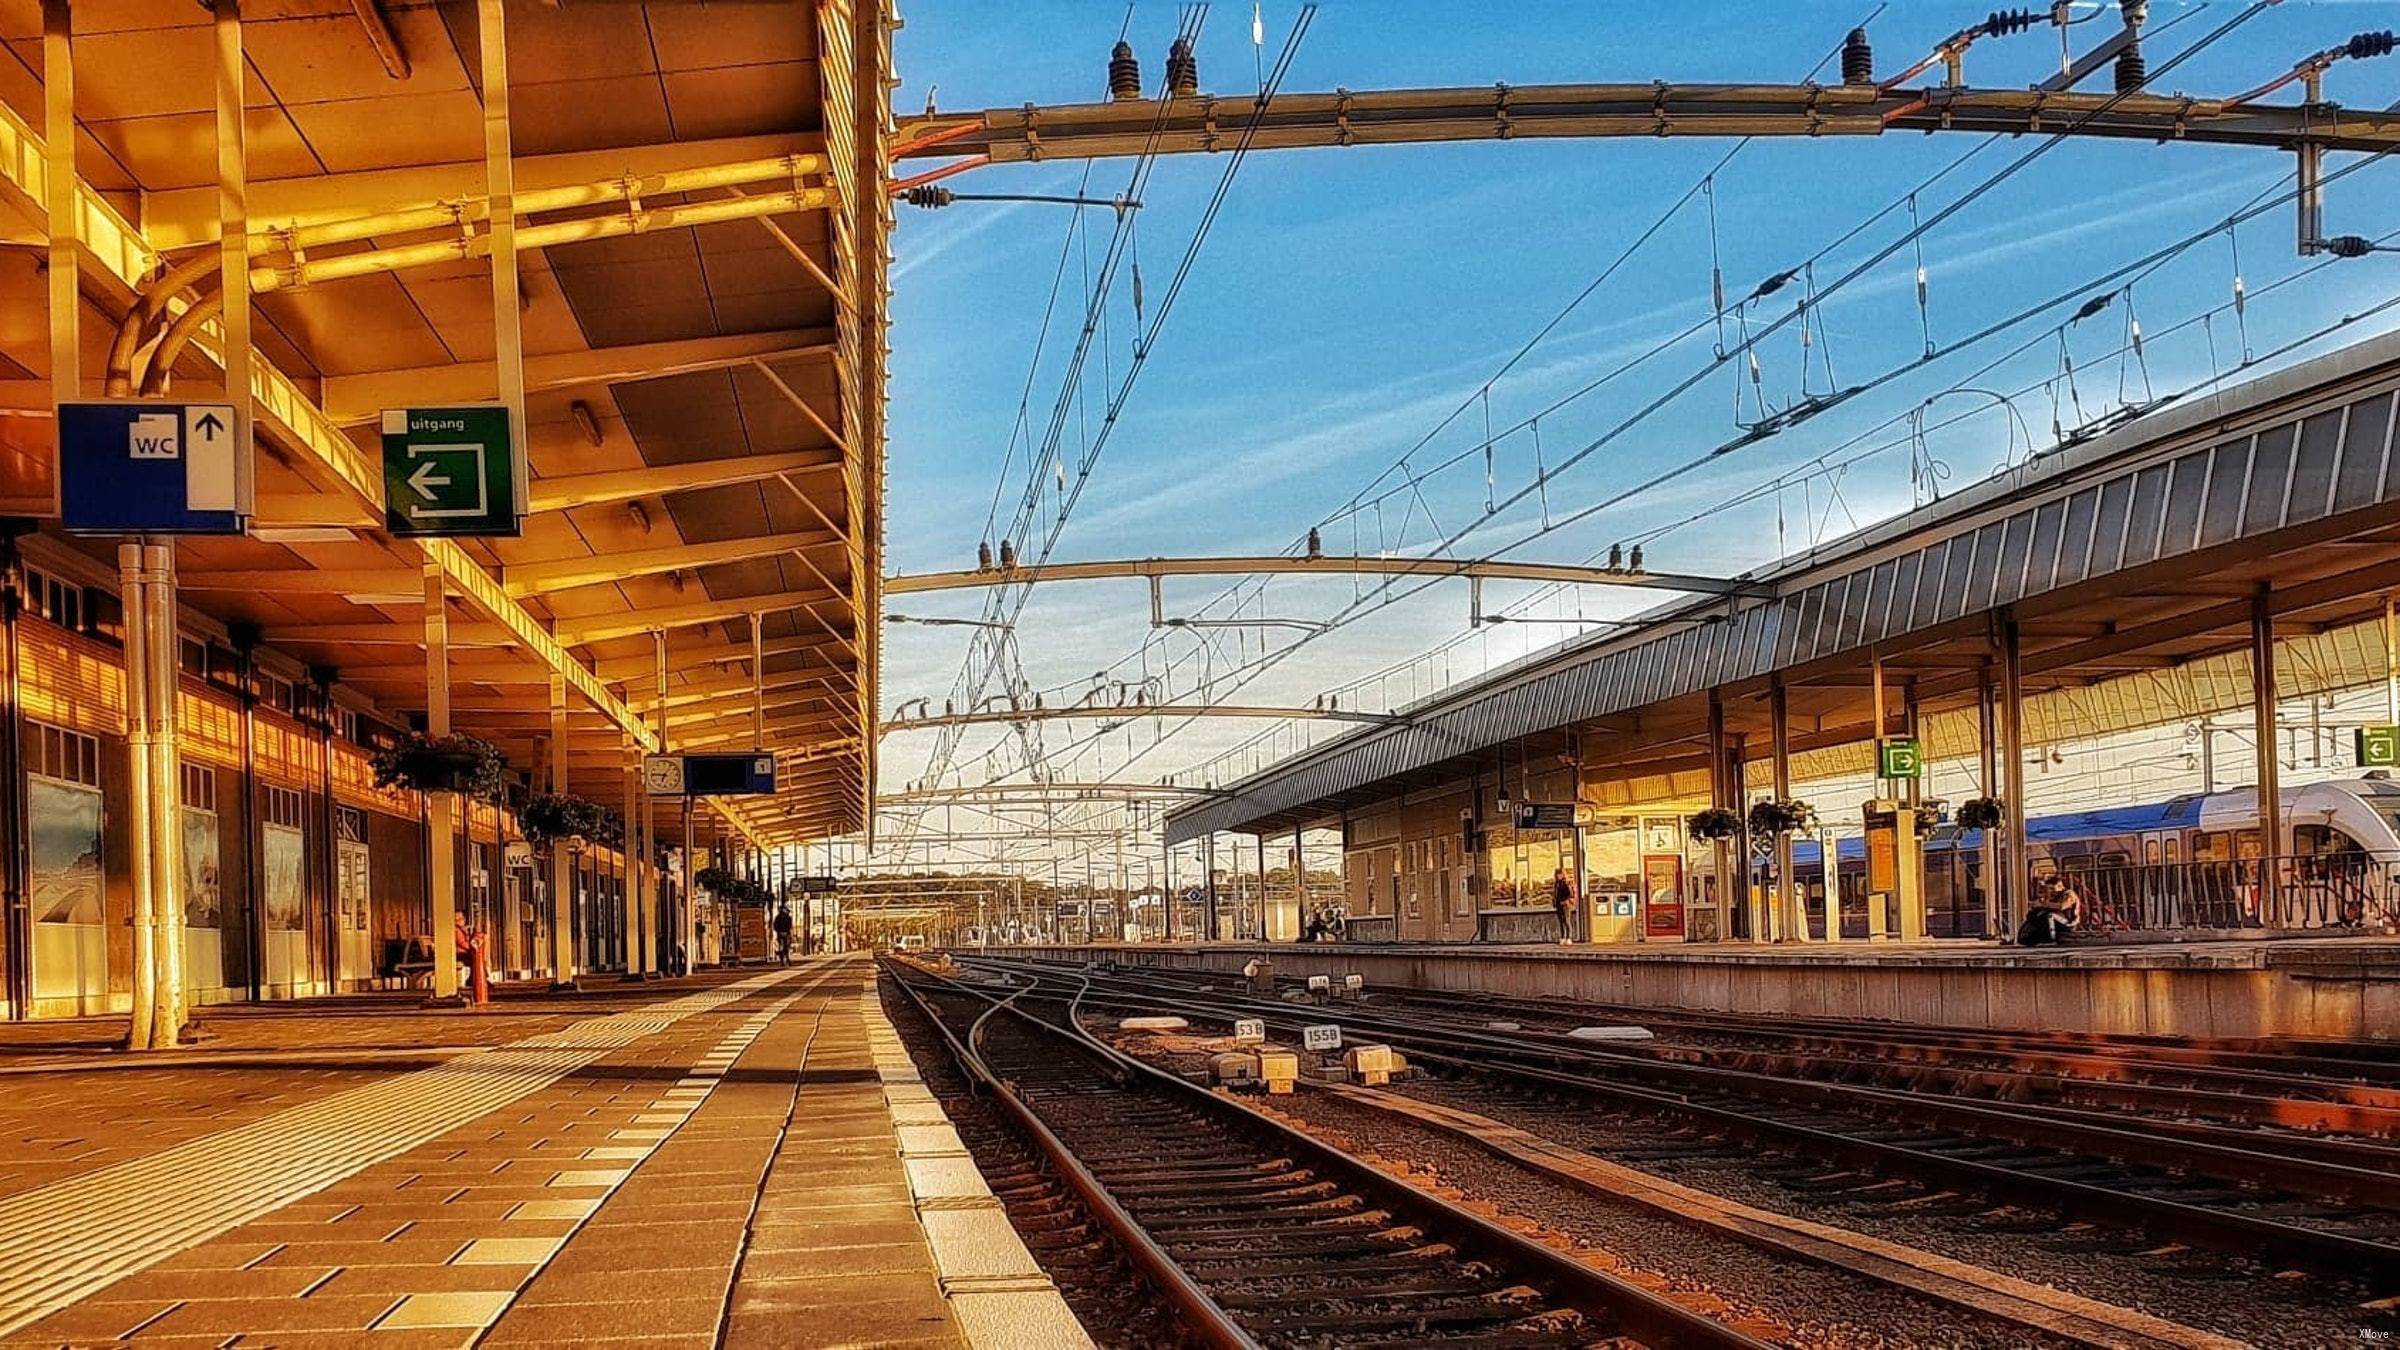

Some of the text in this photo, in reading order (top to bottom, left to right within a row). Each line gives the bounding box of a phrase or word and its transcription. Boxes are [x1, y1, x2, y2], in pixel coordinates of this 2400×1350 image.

[411, 417, 465, 432] uitgang
[135, 437, 175, 454] WC
[508, 854, 530, 865] WC
[1309, 1027, 1338, 1042] 155B
